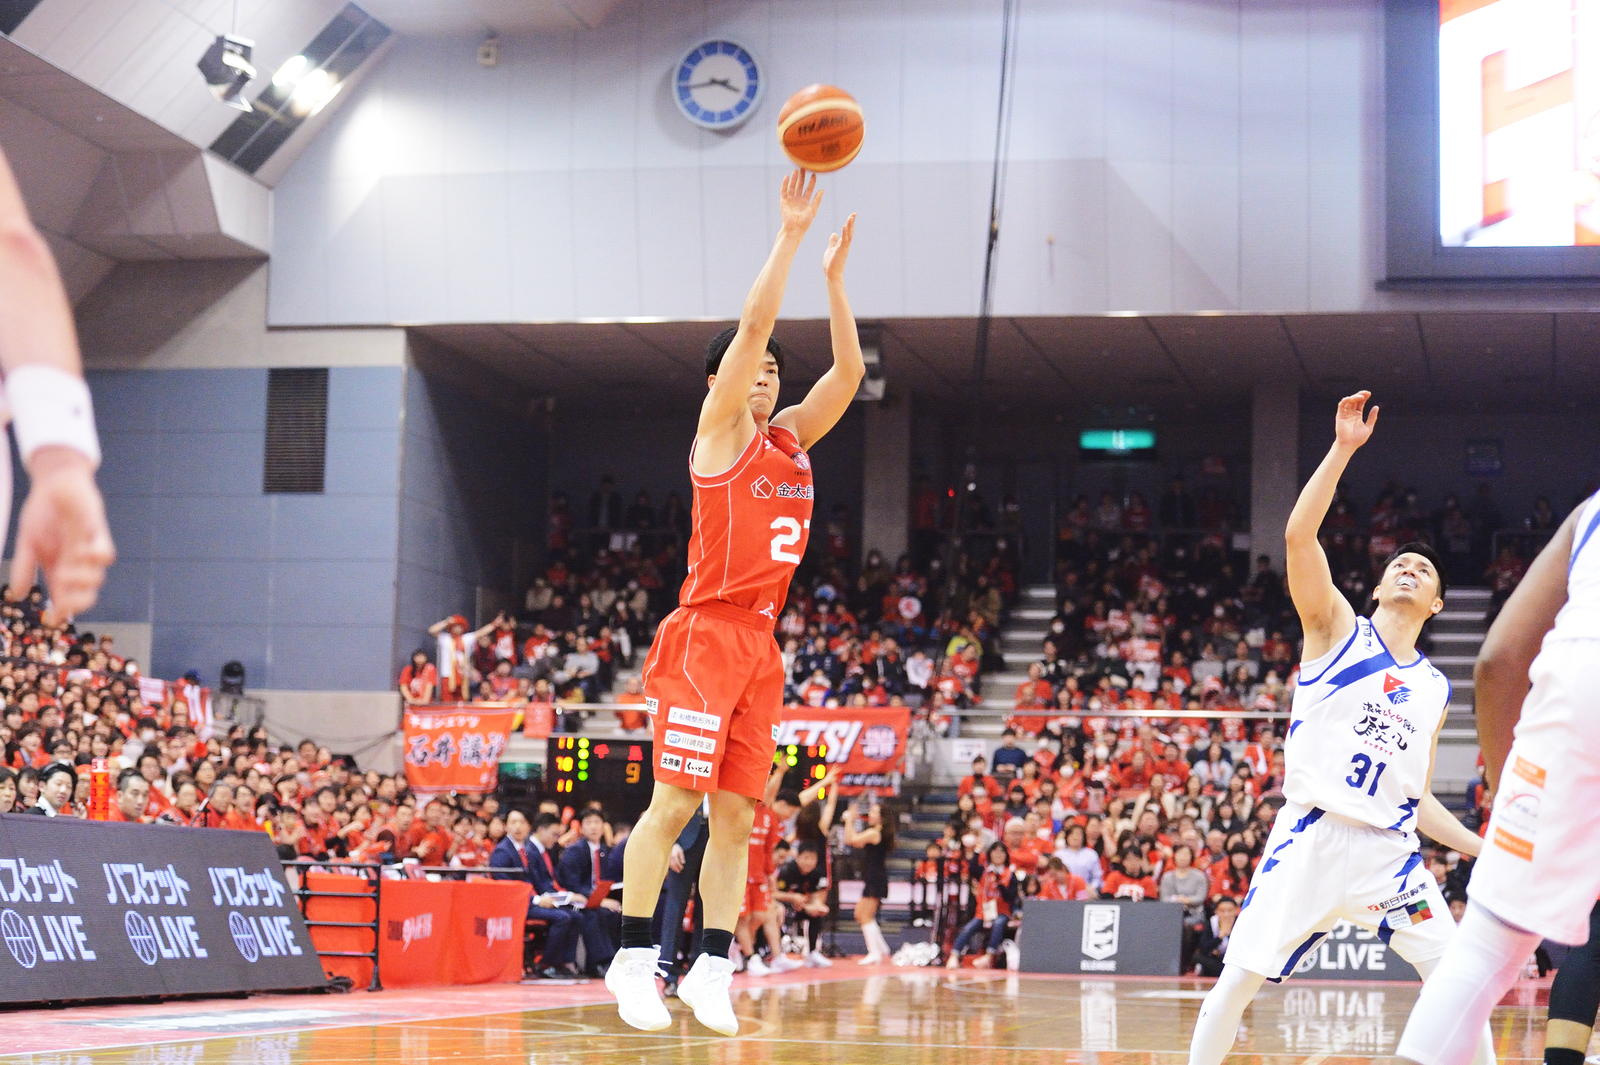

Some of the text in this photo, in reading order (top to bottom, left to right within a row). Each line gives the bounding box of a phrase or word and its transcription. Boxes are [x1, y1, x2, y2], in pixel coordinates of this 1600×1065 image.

[770, 516, 811, 565] 2
[1346, 753, 1387, 797] 31
[102, 863, 191, 906] バスケット
[208, 867, 286, 908] バスケット
[27, 915, 97, 961] LIVE
[147, 916, 208, 959] LIVE
[248, 916, 303, 956] LIVE
[1320, 943, 1387, 970] LIVE
